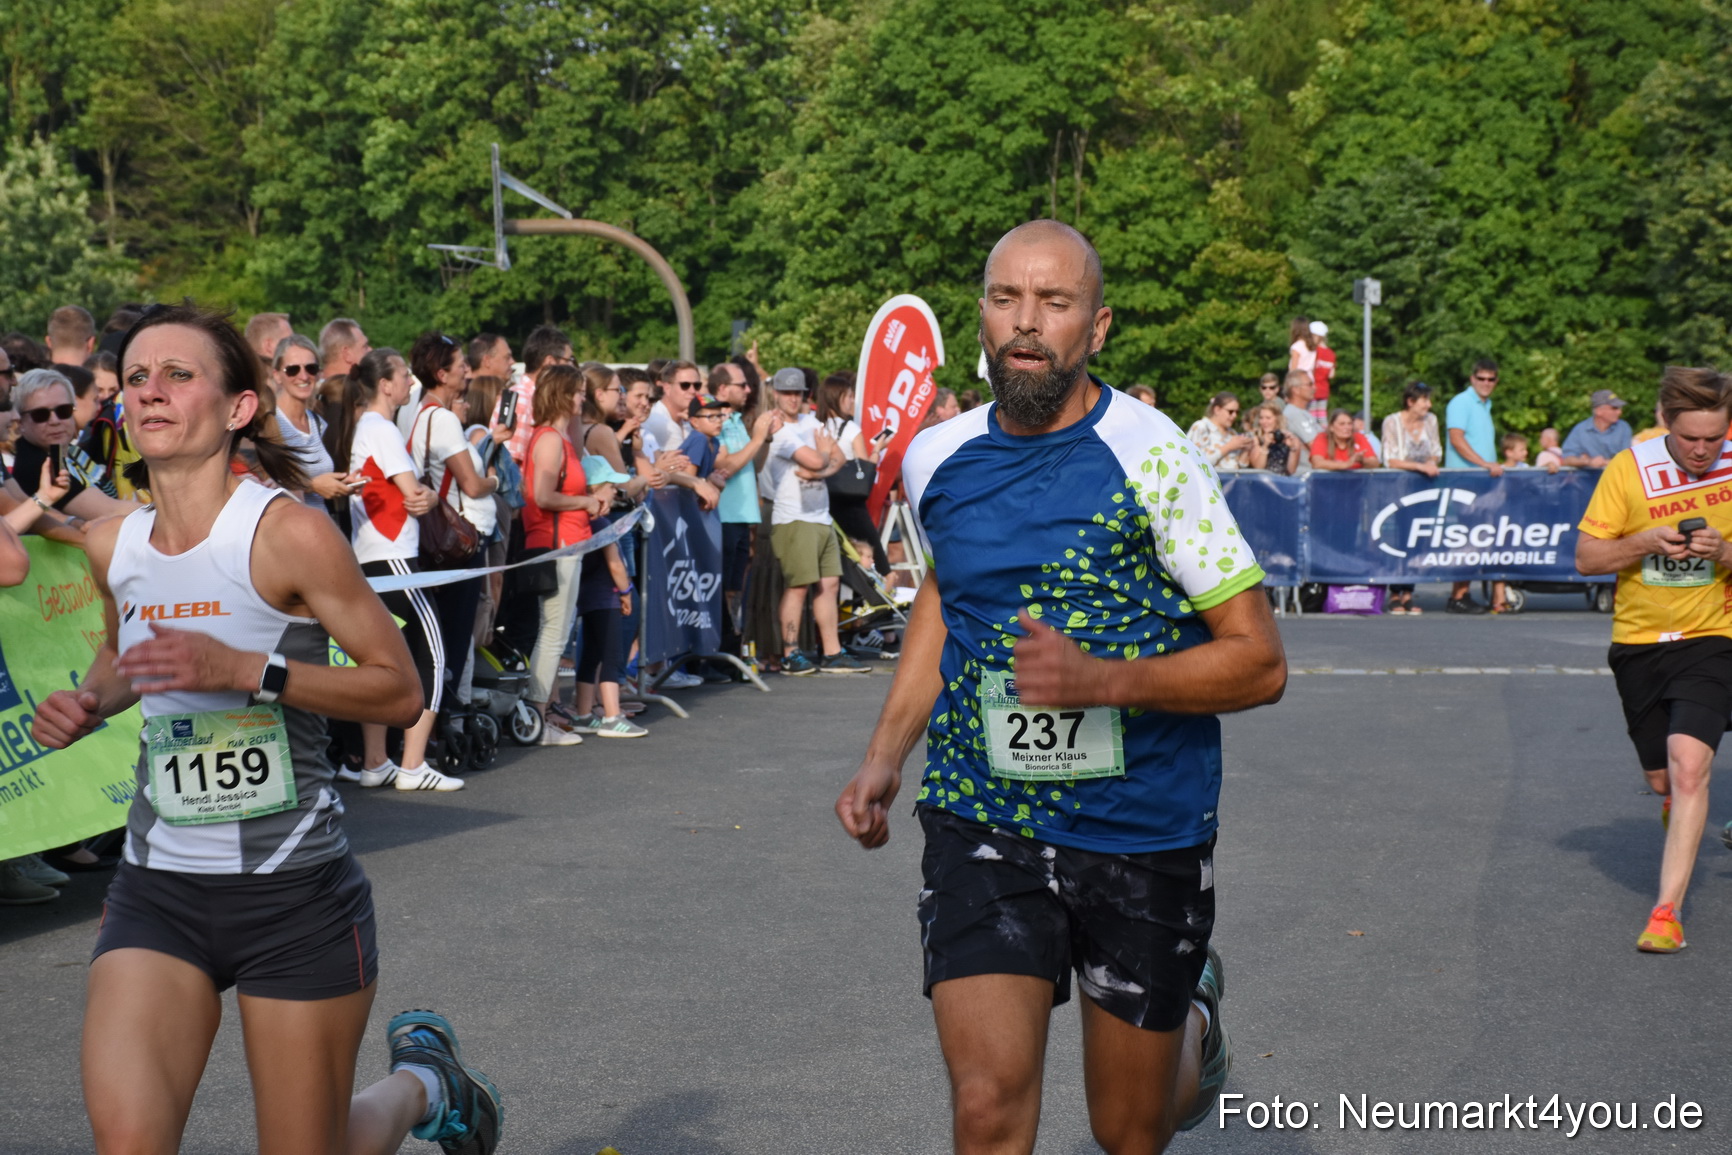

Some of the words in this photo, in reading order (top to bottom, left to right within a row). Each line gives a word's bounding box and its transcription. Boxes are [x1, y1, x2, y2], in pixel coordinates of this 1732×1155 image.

[883, 319, 901, 349] AVIA
[907, 370, 933, 418] ener
[1649, 497, 1699, 520] MAX
[1407, 516, 1571, 548] Fischer
[1422, 551, 1557, 566] AUTOMOBILE
[1650, 553, 1706, 573] 1652
[37, 562, 103, 622] Gesund
[140, 601, 232, 621] KLEBL
[997, 692, 1021, 705] firme
[249, 732, 277, 745] 2019
[1007, 711, 1085, 751] 237
[1012, 752, 1052, 762] Meixner
[1055, 751, 1087, 761] Klaus
[165, 747, 270, 794] 1159
[213, 789, 258, 803] Jessica
